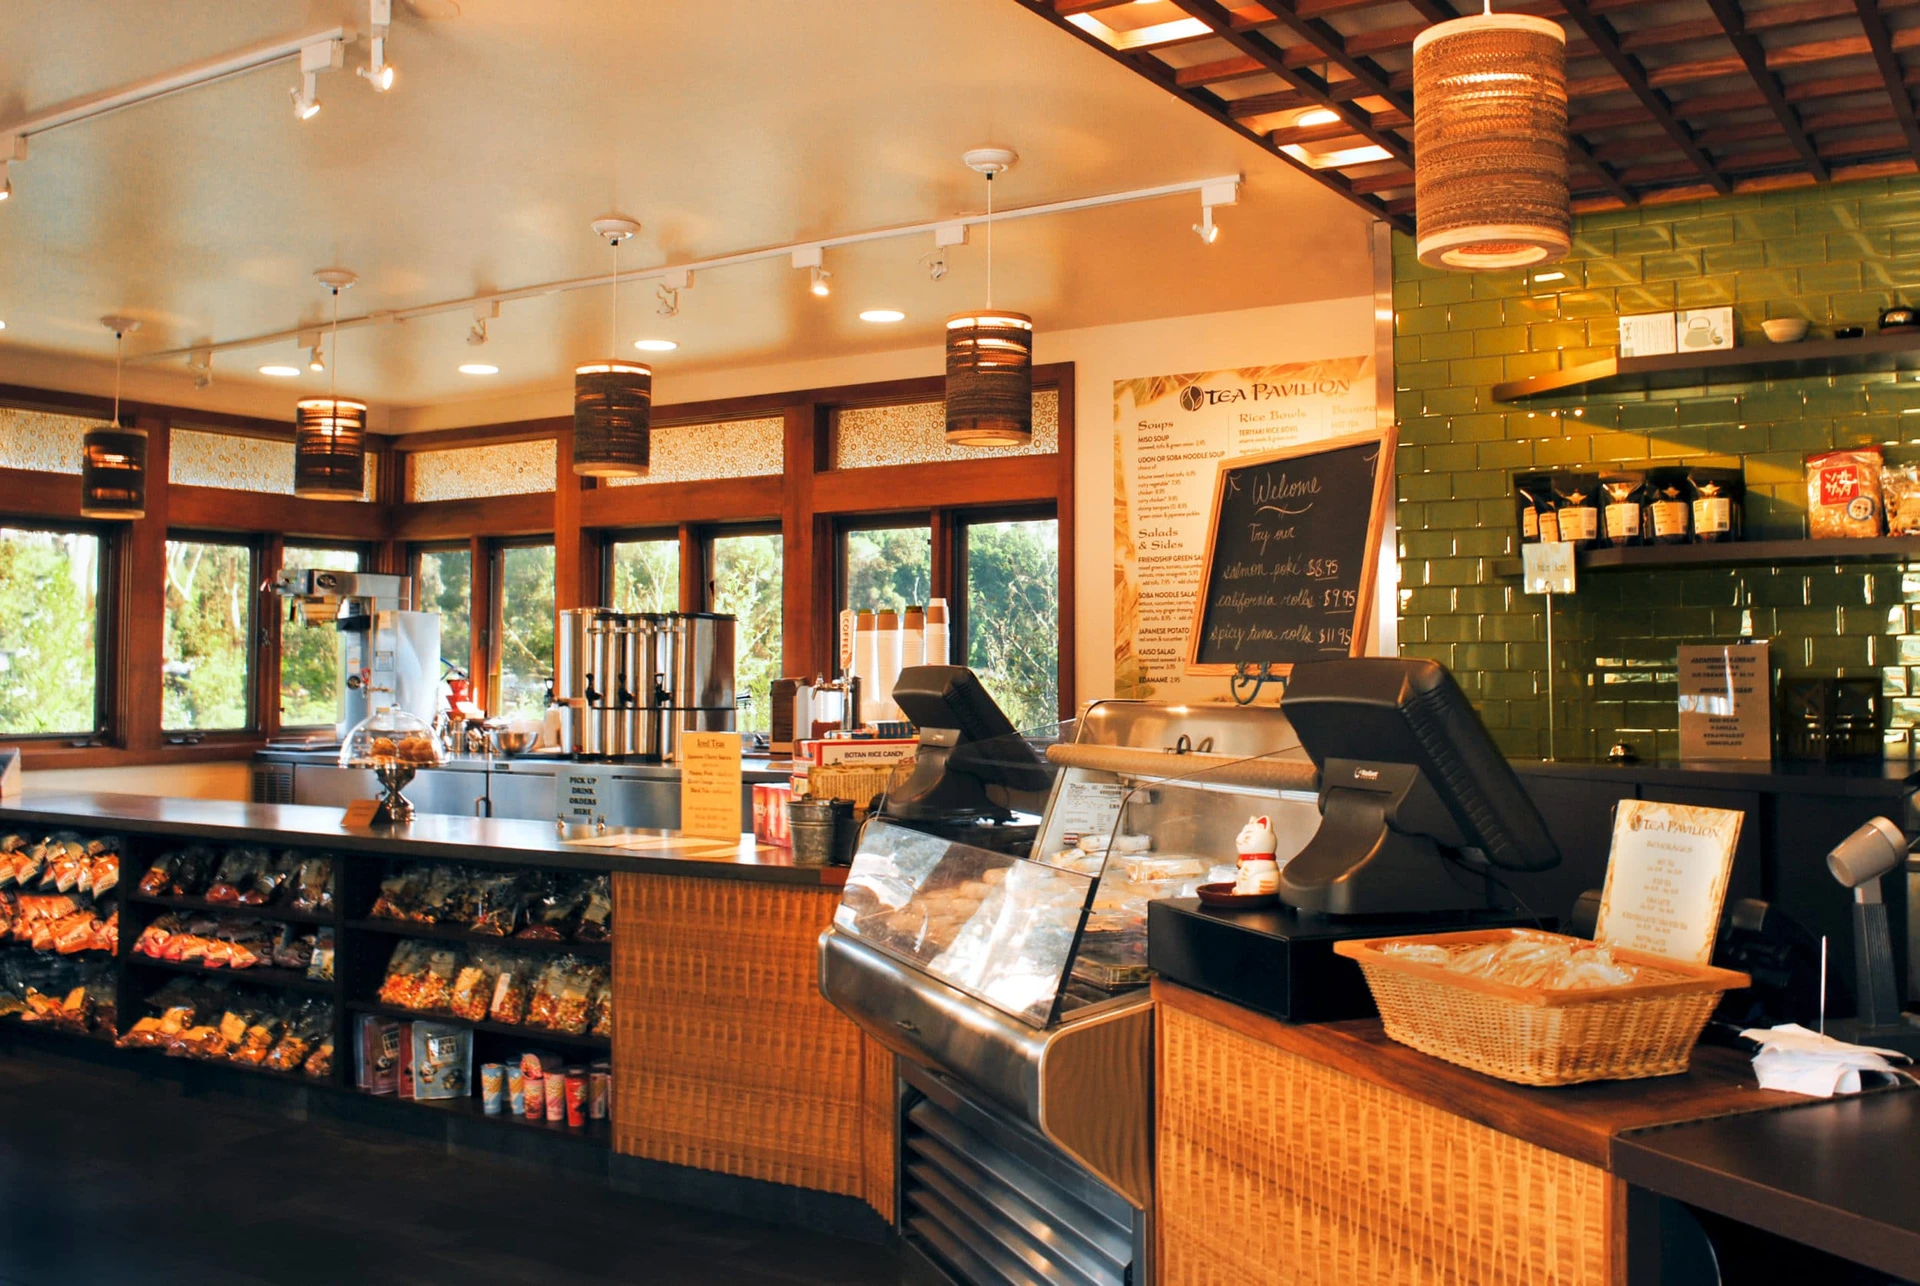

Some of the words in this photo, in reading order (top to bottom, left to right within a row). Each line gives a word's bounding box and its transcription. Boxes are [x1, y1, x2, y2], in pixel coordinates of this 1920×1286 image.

[1205, 389, 1247, 405] TEA
[1252, 380, 1350, 400] PAVILION
[1240, 413, 1266, 422] Rice
[1270, 408, 1306, 420] Bowls
[1138, 421, 1173, 431] Soups
[1138, 455, 1155, 463] UDON
[1253, 472, 1322, 505] Welcome
[1139, 527, 1178, 538] Salads
[1248, 522, 1271, 556] Try
[1273, 526, 1296, 539] our
[1138, 541, 1147, 550] &
[1151, 540, 1183, 550] Sides
[1223, 561, 1268, 580] salmon
[1216, 589, 1277, 613] california
[1281, 589, 1315, 608] rolls
[1209, 623, 1245, 650] spicy
[1248, 624, 1278, 641] tuna
[1280, 625, 1313, 643] rolls
[844, 751, 867, 759] BOTAN
[570, 776, 585, 784] PICK
[569, 797, 596, 805] ORDERS
[1644, 819, 1664, 830] TEA
[1667, 821, 1719, 837] PAVILION
